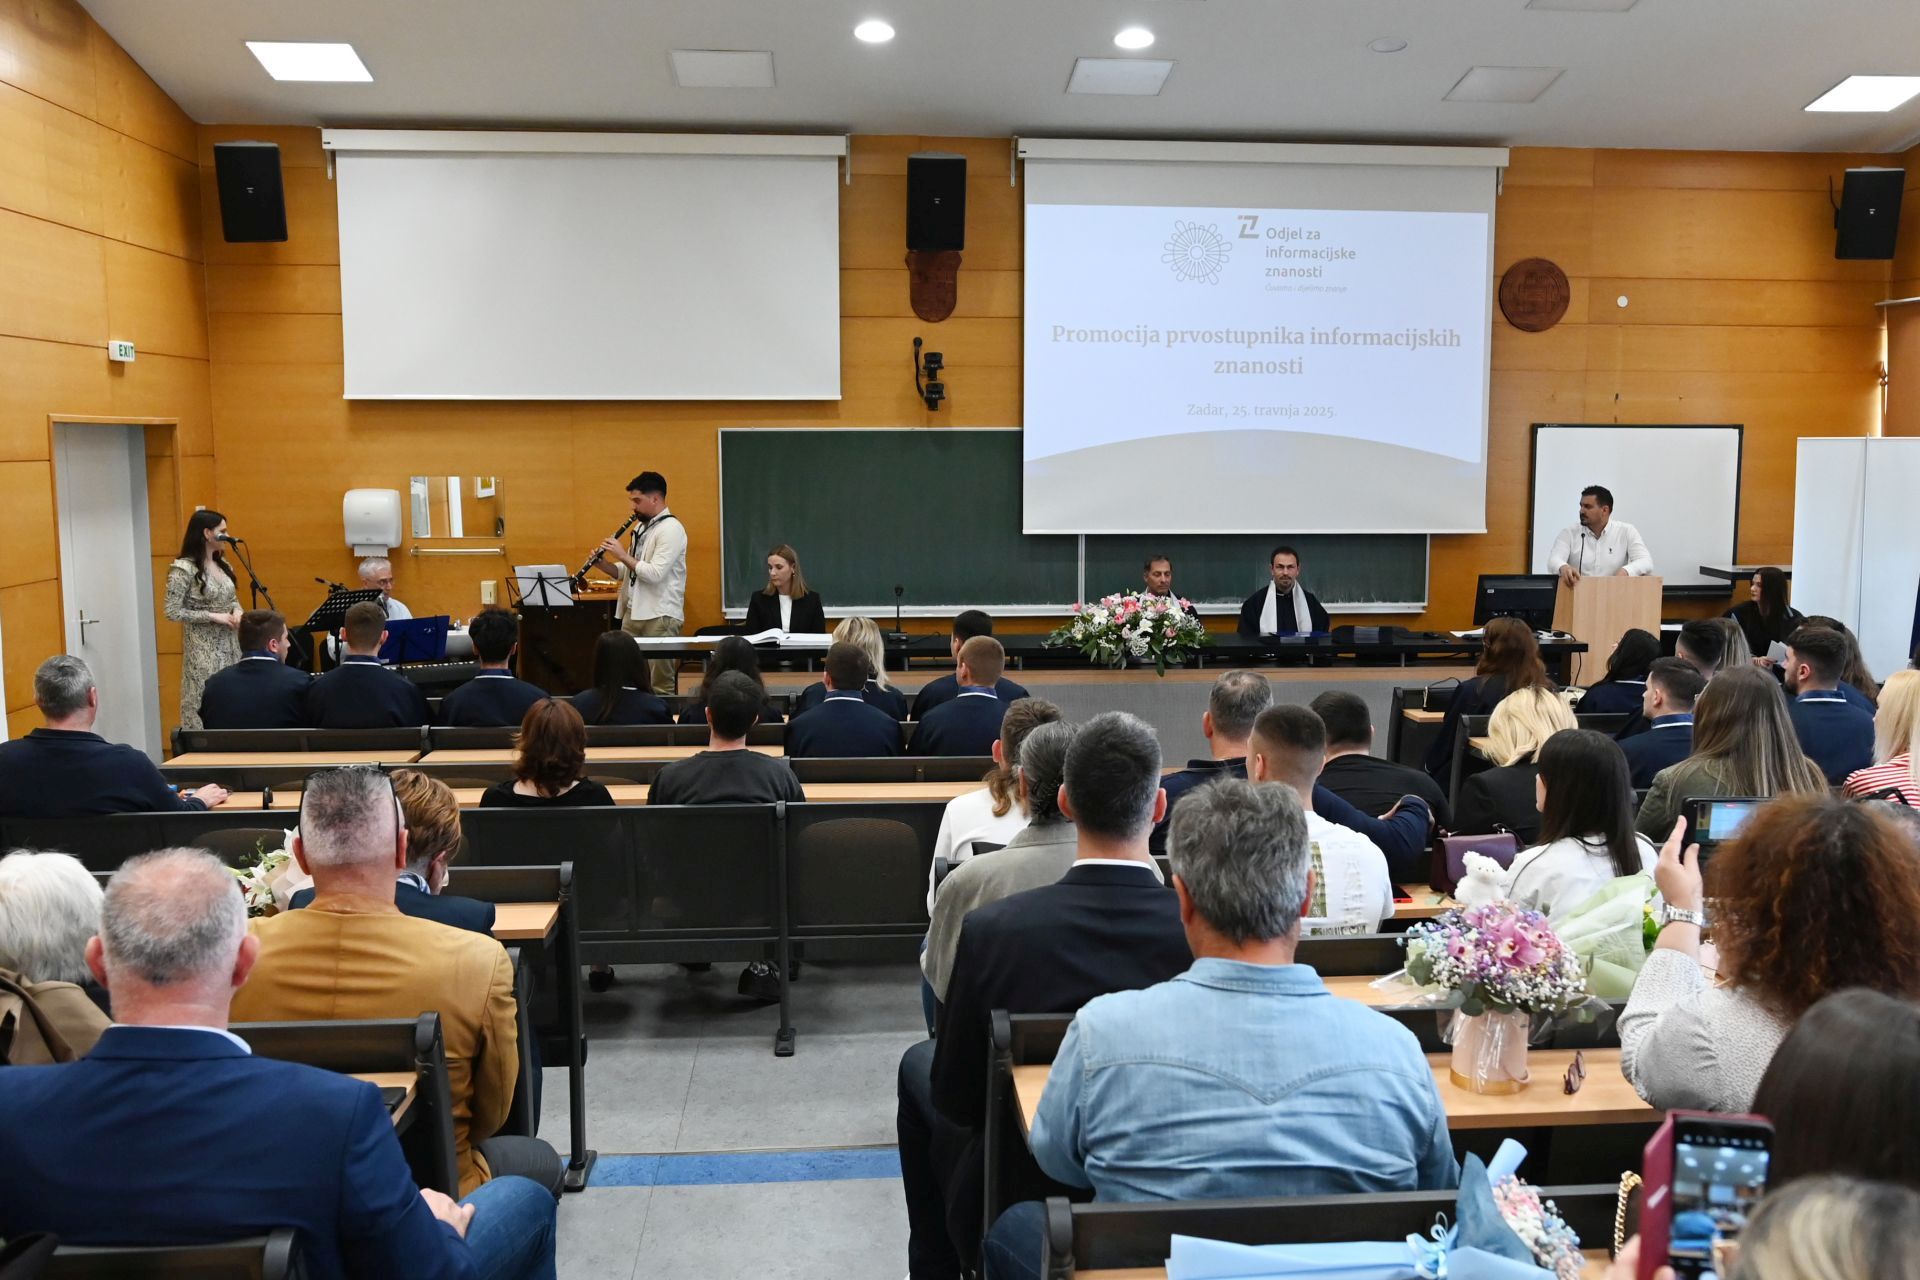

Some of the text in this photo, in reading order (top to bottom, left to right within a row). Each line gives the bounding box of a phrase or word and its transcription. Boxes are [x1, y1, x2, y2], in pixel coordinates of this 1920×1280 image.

[1266, 227, 1321, 241] Odjel za
[1265, 246, 1356, 262] informacijske
[1265, 265, 1323, 278] znanosti
[1052, 325, 1461, 351] Promocija prvostupnika informacijskih
[119, 344, 134, 358] EXIT
[1214, 356, 1303, 374] znanosti
[1187, 403, 1337, 419] Zadar, 25. travnja 2025.
